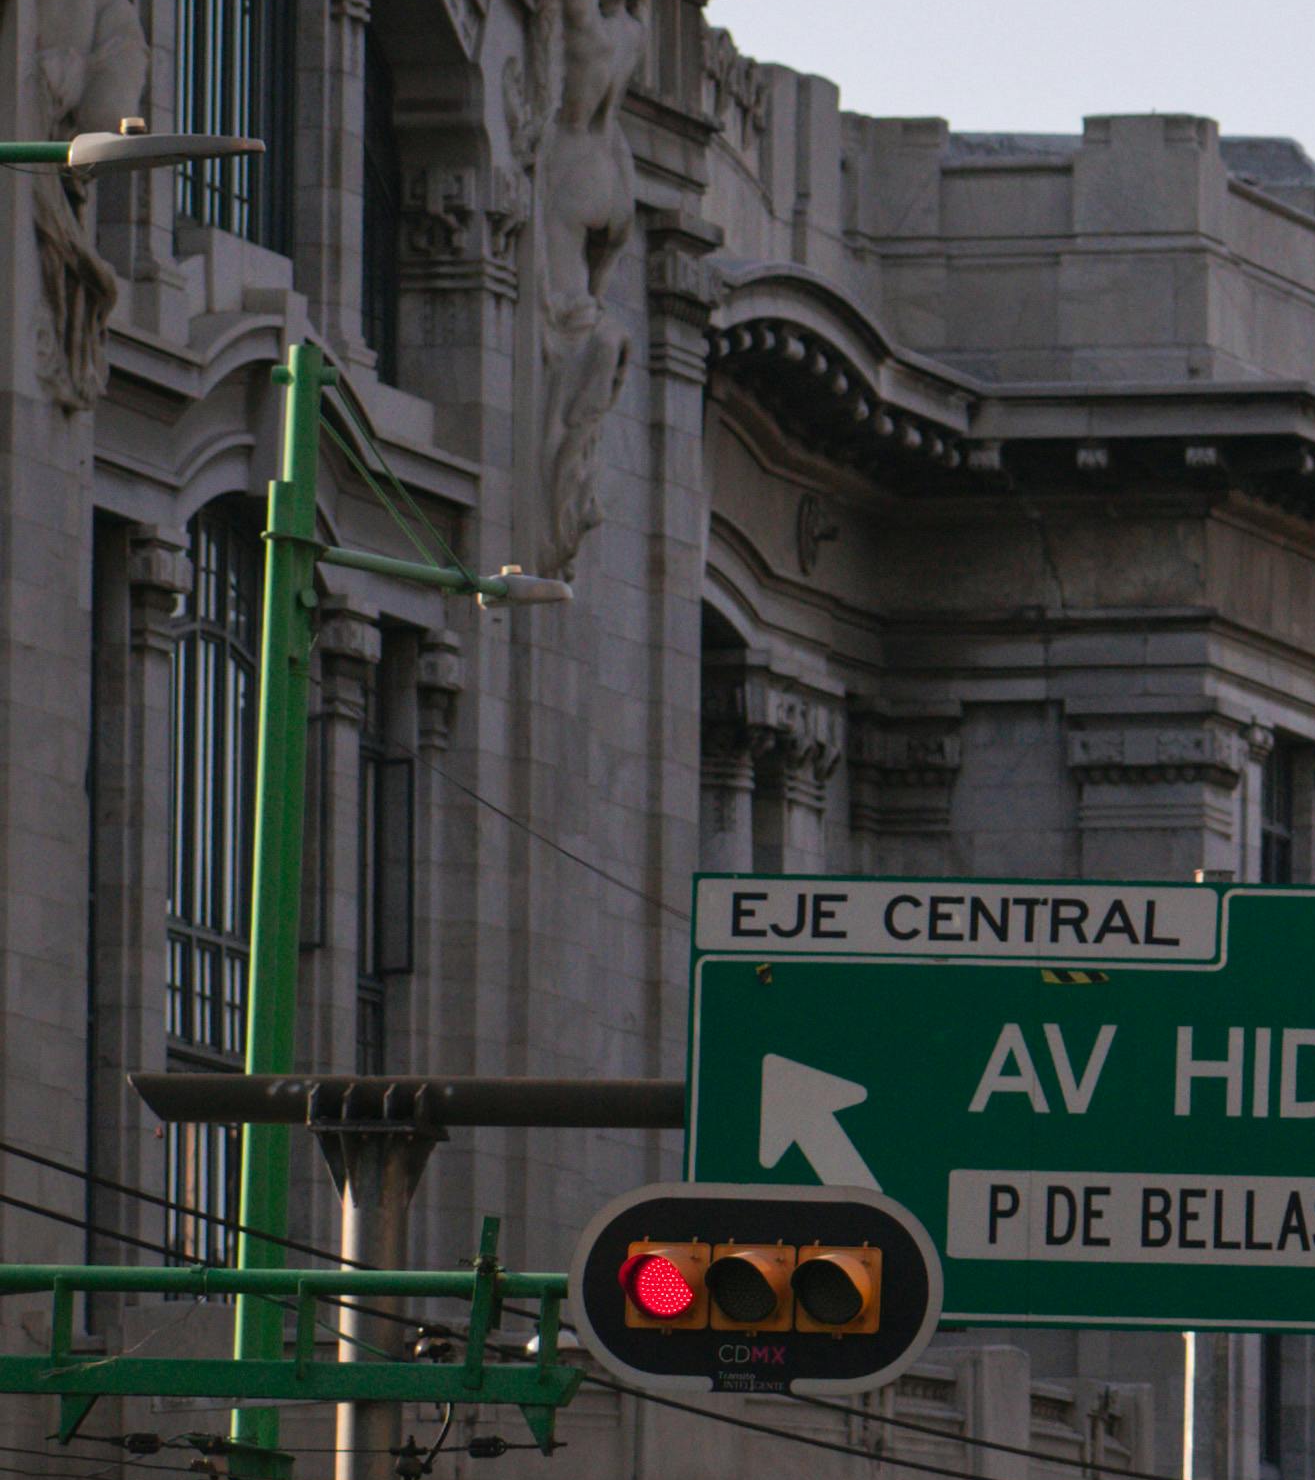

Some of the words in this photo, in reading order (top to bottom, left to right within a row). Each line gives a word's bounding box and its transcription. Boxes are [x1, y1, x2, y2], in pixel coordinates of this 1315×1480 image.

[731, 892, 848, 939] EJE
[884, 894, 1181, 947] CENTRAL
[967, 1023, 1117, 1115] AV
[987, 1184, 1020, 1245] P
[1045, 1185, 1111, 1247] DE
[718, 1344, 787, 1365] CDMX
